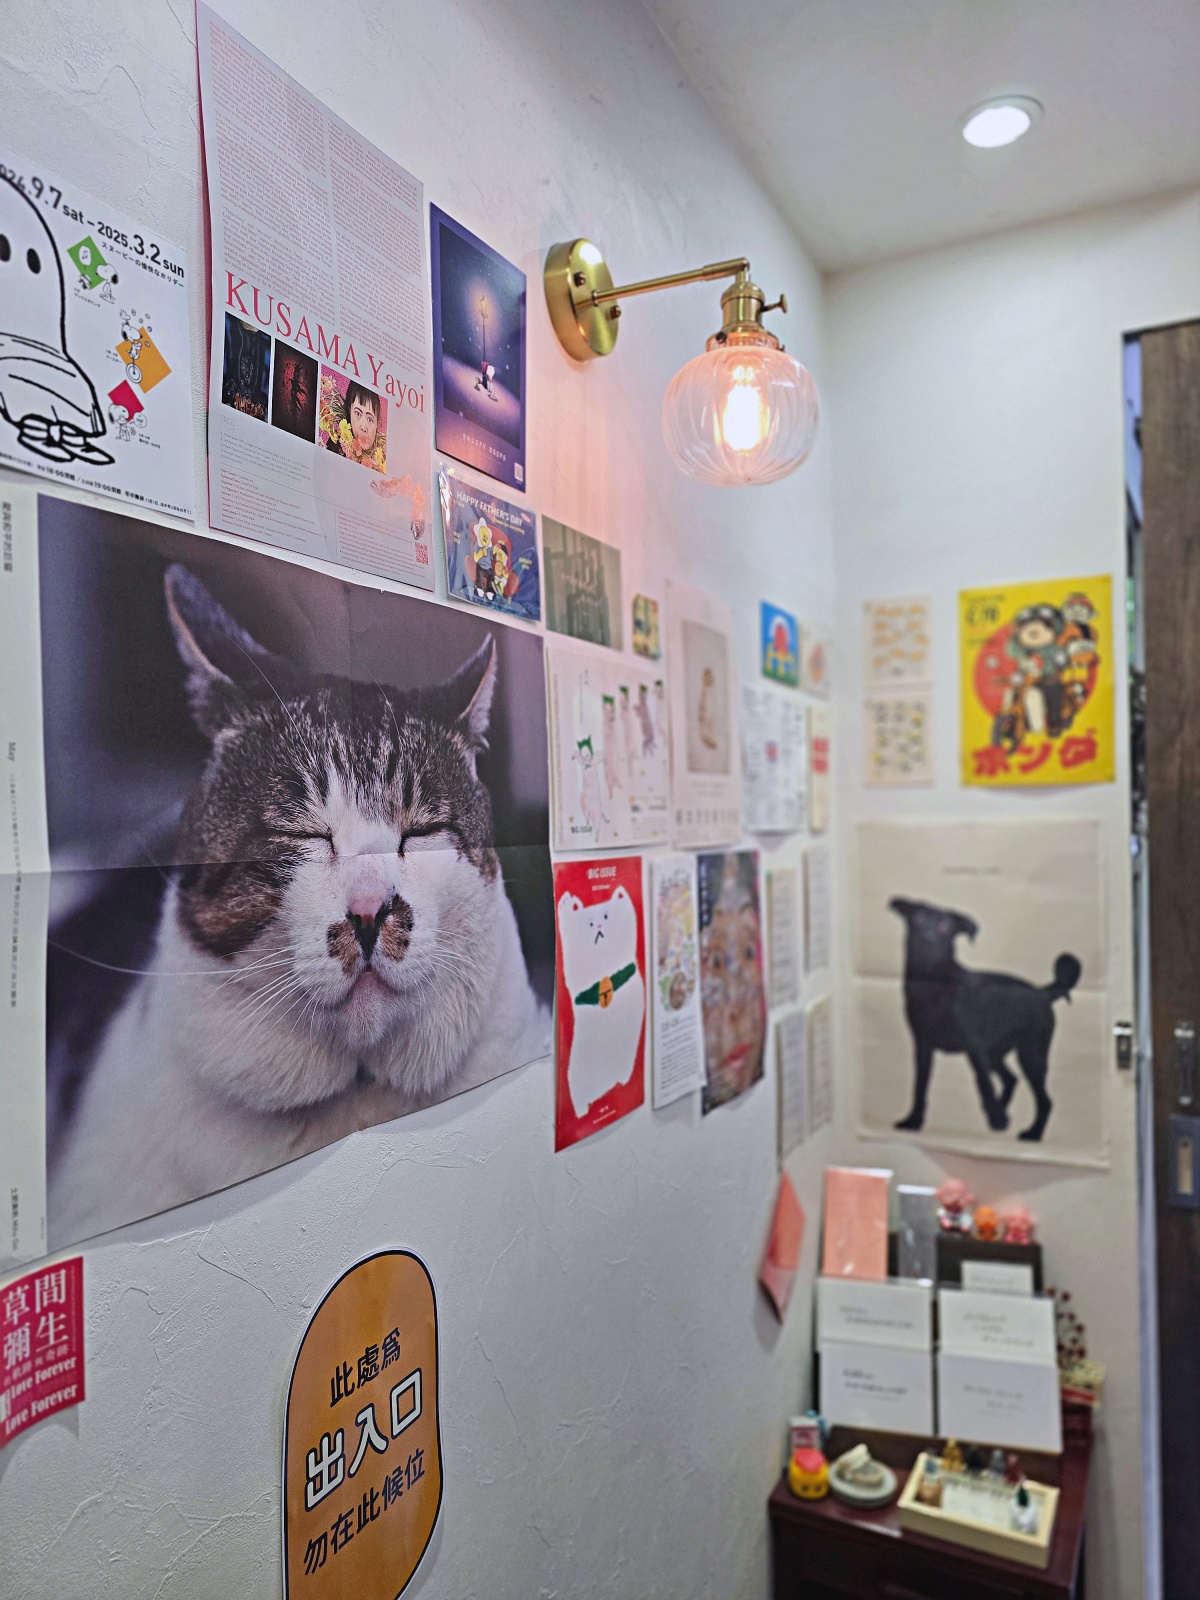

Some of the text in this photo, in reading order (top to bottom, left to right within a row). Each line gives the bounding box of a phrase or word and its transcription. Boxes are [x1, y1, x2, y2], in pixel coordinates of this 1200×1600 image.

[63, 204, 84, 225] sat
[163, 259, 185, 279] sun
[224, 269, 361, 378] KUSAMA
[366, 352, 426, 414] Yayoi
[462, 433, 507, 462] SNOOPY DROPS
[456, 490, 479, 508] HAPPY
[479, 501, 510, 522] FATHER'S
[510, 513, 523, 526] DAY
[7, 741, 17, 762] May
[587, 865, 616, 880] BIG ISSUE
[2, 1268, 67, 1328] 草間
[2, 1311, 69, 1370] 彌生
[35, 1357, 77, 1385] Forever
[31, 1384, 78, 1417] Forever
[304, 1367, 422, 1512] 出入口
[304, 1448, 425, 1575] 勿在此候位
